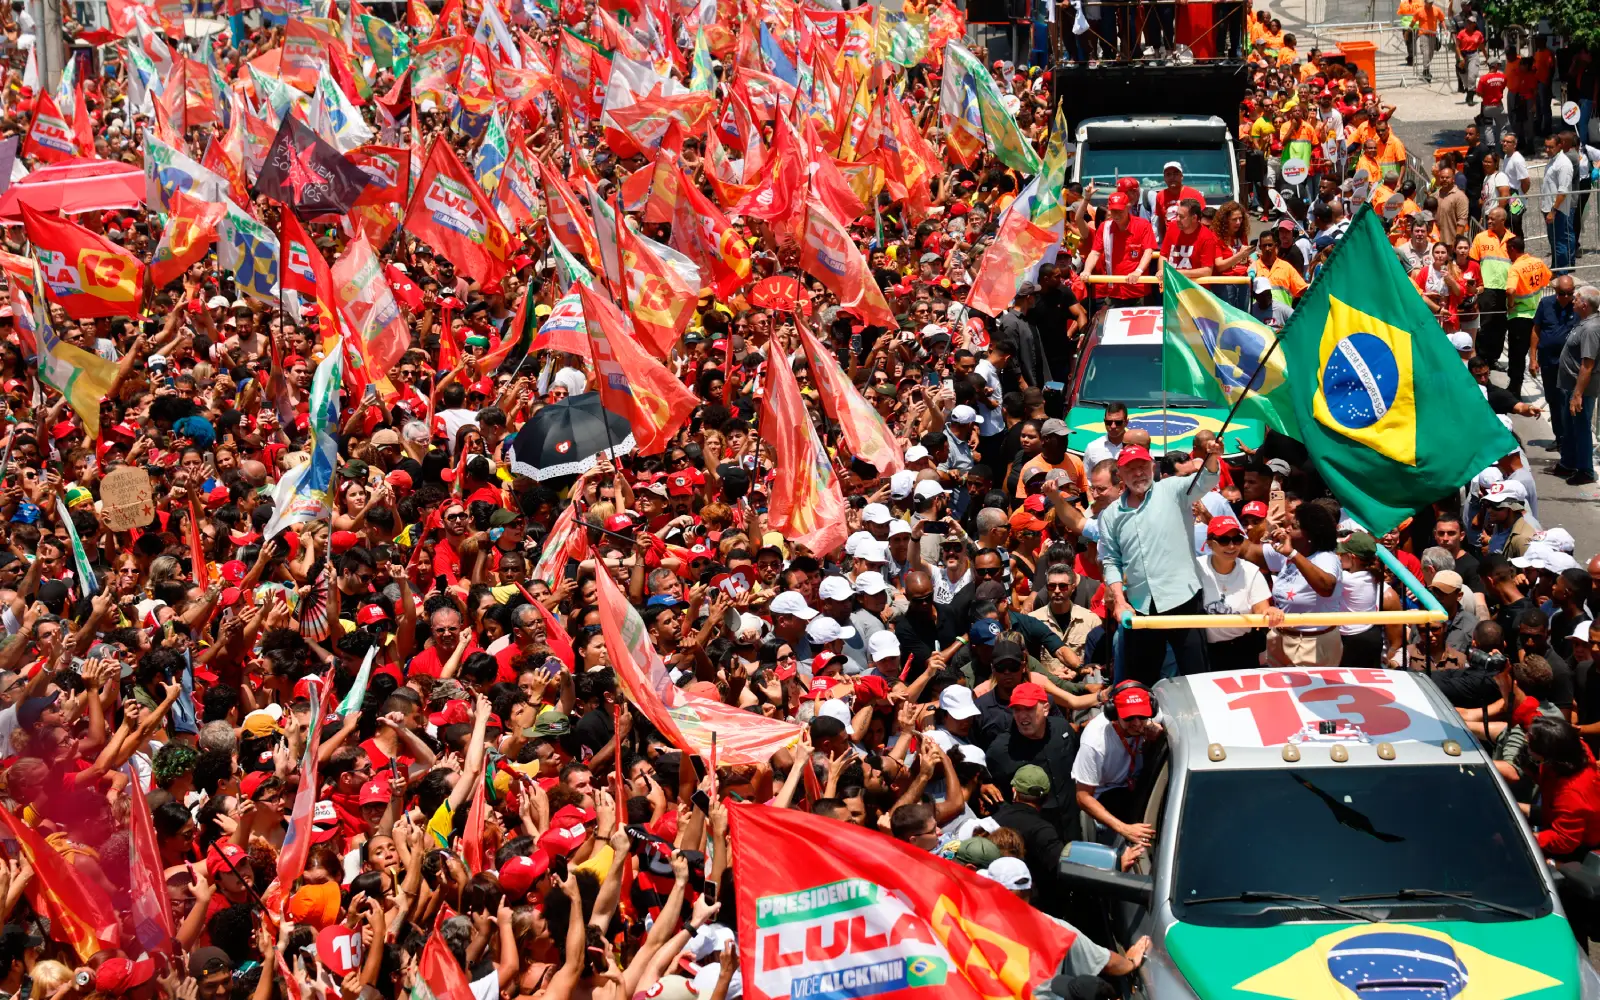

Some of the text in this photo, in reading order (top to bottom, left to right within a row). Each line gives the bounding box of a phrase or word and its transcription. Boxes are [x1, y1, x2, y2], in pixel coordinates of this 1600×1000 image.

[428, 184, 485, 226] LULA
[1168, 257, 1192, 269] LA
[1169, 244, 1194, 258] LU
[1481, 244, 1495, 252] 393
[82, 255, 124, 288] 13
[1529, 273, 1543, 287] 481
[640, 279, 675, 312] 13
[1340, 341, 1384, 415] ORDEM E PROGRESSO
[719, 572, 750, 598] 13
[1213, 669, 1393, 694] VOTE
[1227, 685, 1411, 746] 13
[759, 881, 870, 919] PRESIDENTE
[333, 934, 362, 971] 13
[762, 913, 936, 972] LULA
[794, 960, 904, 998] VICE ALCKMIN
